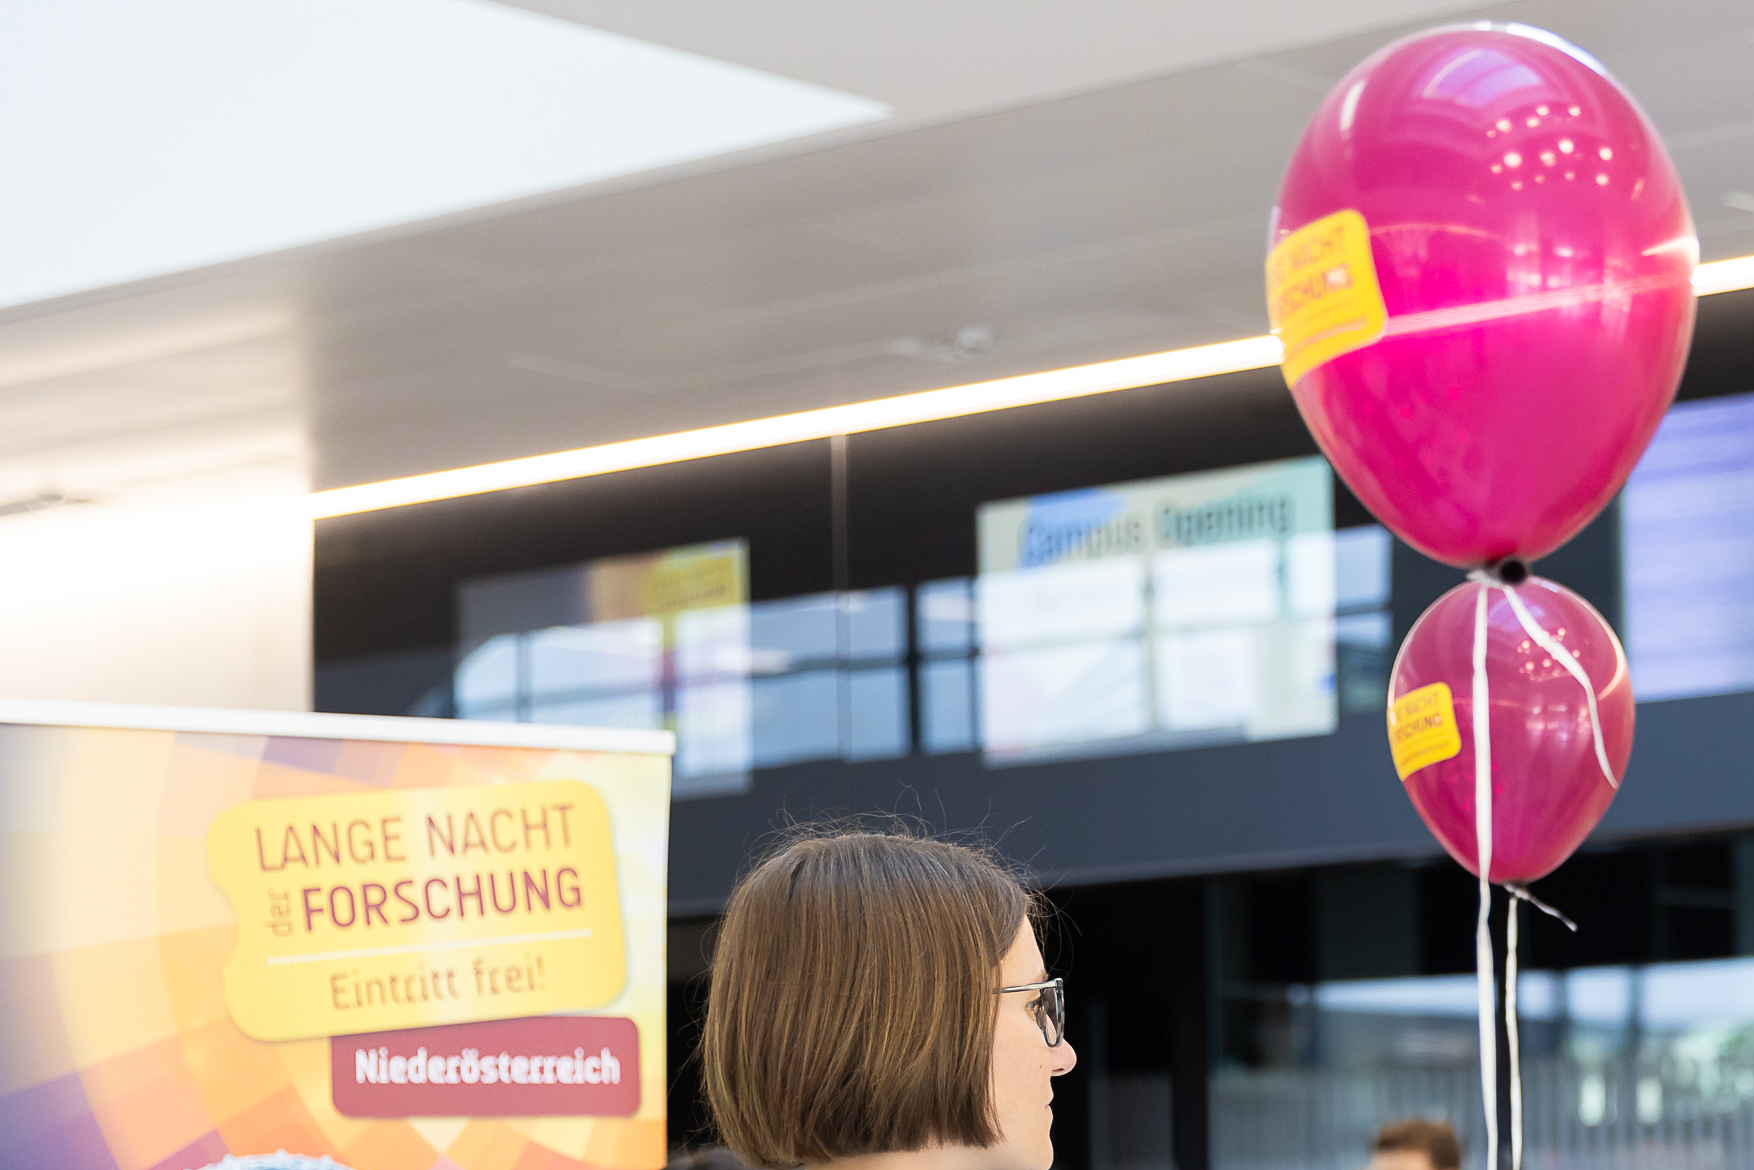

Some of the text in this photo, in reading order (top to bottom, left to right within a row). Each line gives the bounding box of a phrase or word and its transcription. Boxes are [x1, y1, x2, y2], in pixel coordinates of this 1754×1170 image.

[1018, 494, 1297, 568] Campus Opening
[255, 803, 578, 874] LANGE NACHT
[265, 889, 292, 938] der
[301, 866, 584, 934] FORSCHUNG
[330, 955, 549, 1012] Eintritt frei!
[354, 1046, 622, 1086] Niederösterreich
